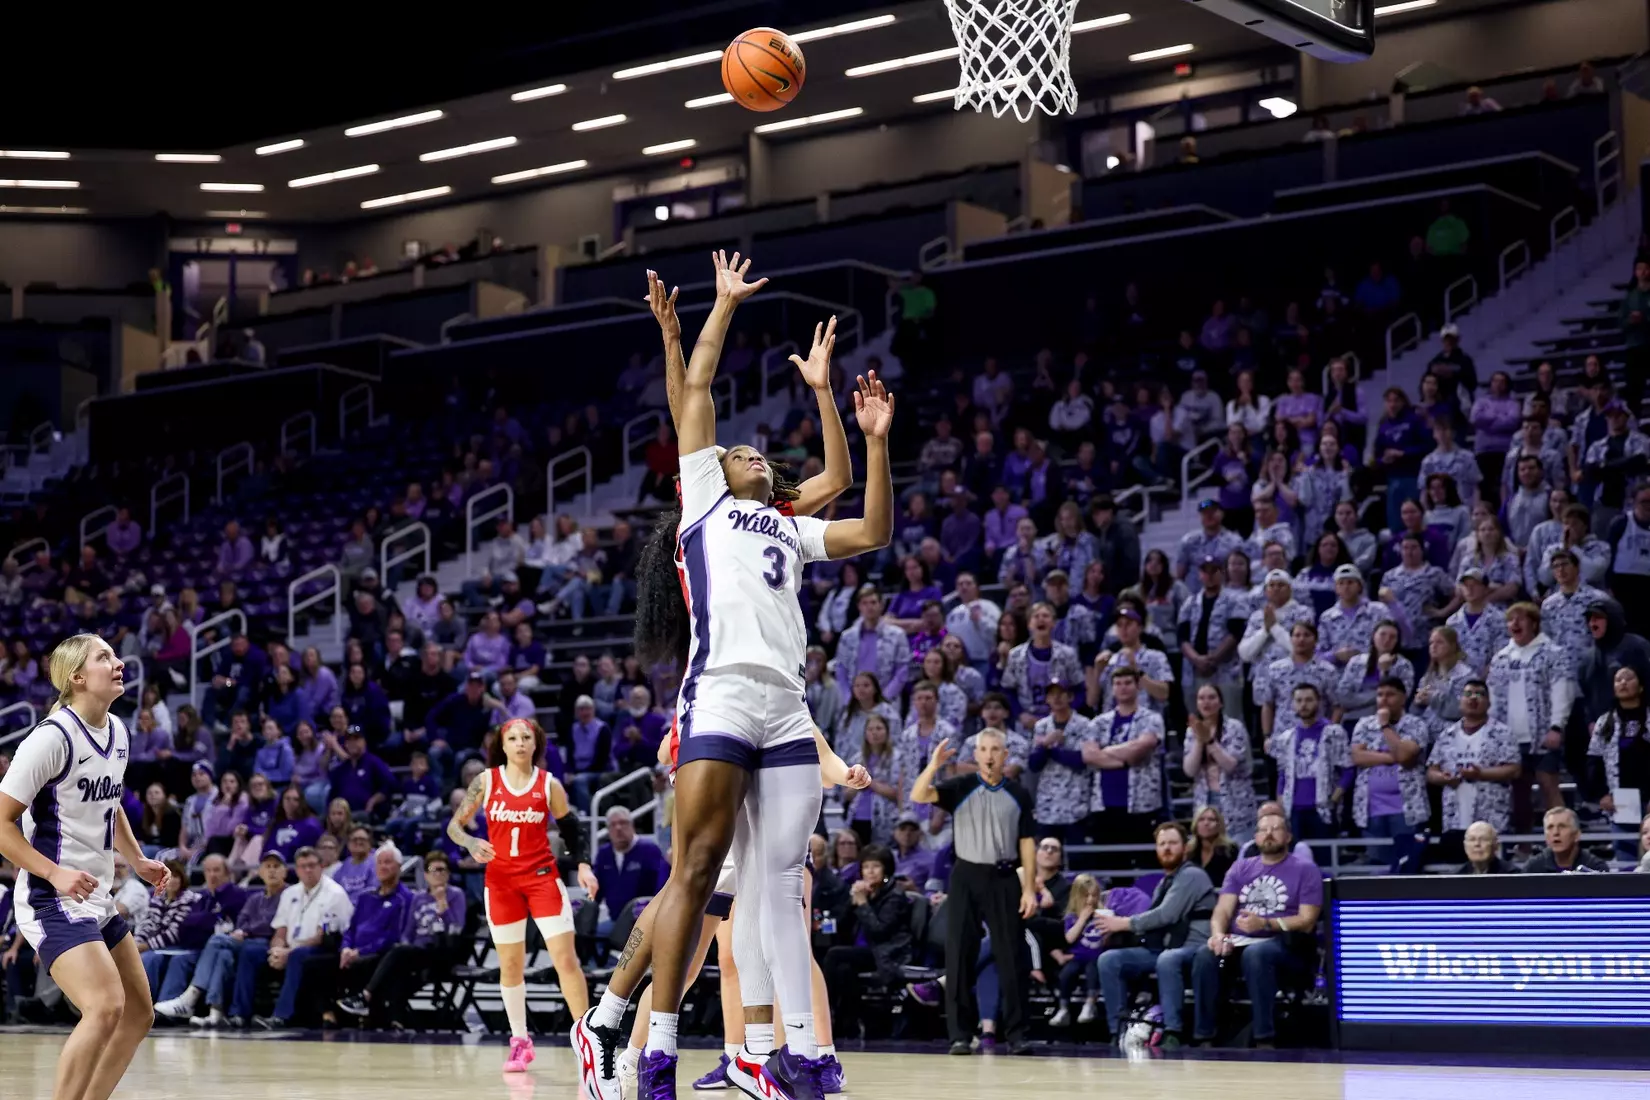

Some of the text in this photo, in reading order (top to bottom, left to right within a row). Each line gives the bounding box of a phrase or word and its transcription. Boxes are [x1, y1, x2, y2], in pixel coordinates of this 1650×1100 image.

[762, 545, 787, 592] 3
[489, 800, 545, 824] Houston
[509, 826, 520, 857] 1
[1377, 944, 1504, 980] When
[1512, 953, 1595, 990] you
